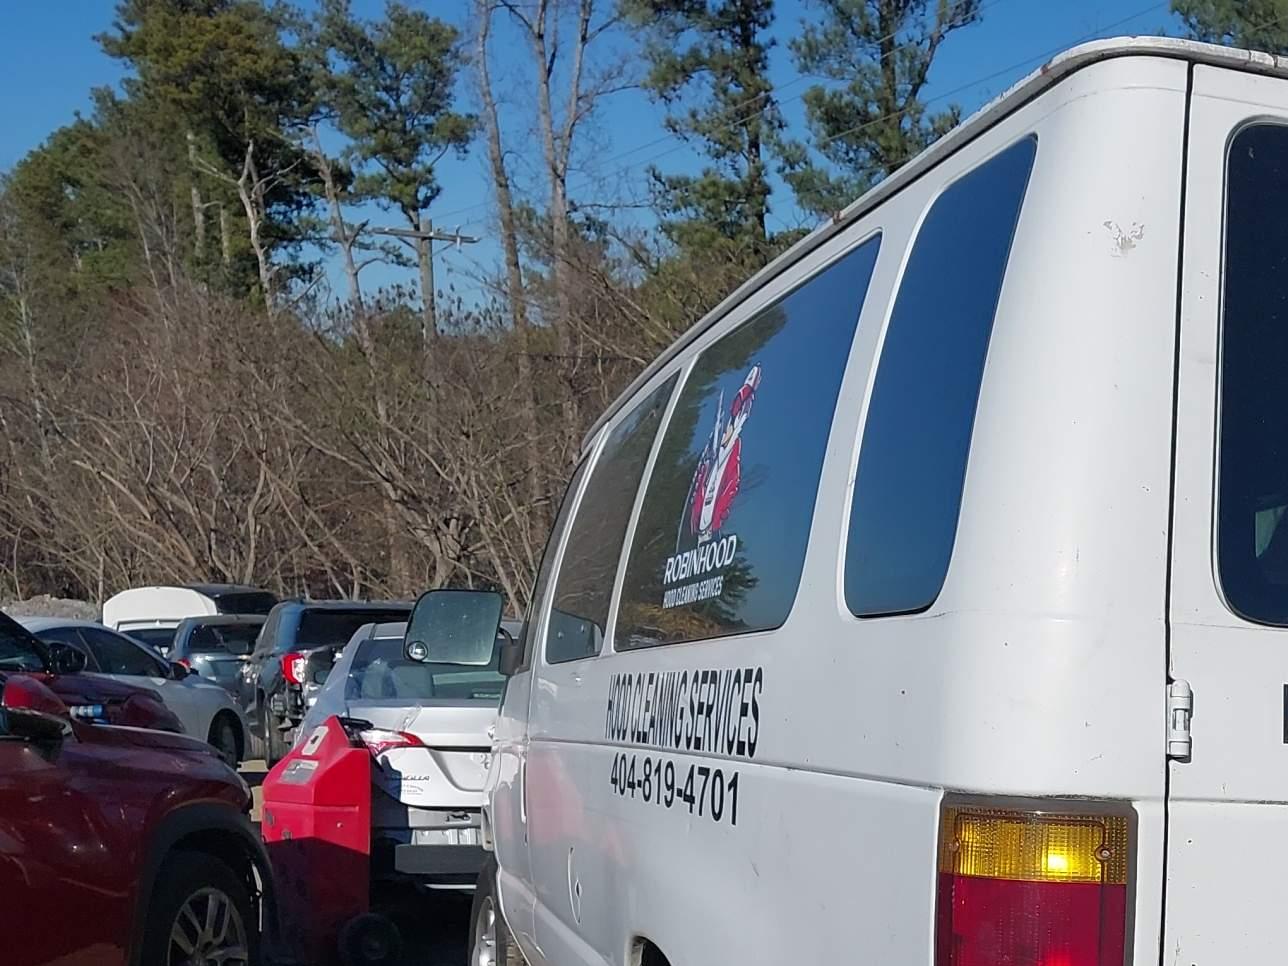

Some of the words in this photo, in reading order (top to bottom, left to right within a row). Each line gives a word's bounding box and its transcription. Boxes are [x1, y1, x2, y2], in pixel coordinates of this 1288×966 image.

[663, 535, 737, 585] ROBINHOOD
[698, 575, 724, 600] SERVICES
[605, 673, 633, 742] HOOD
[631, 670, 688, 749] CLEANING
[686, 666, 763, 758] SERVICES
[610, 752, 740, 826] 404-819-4701
